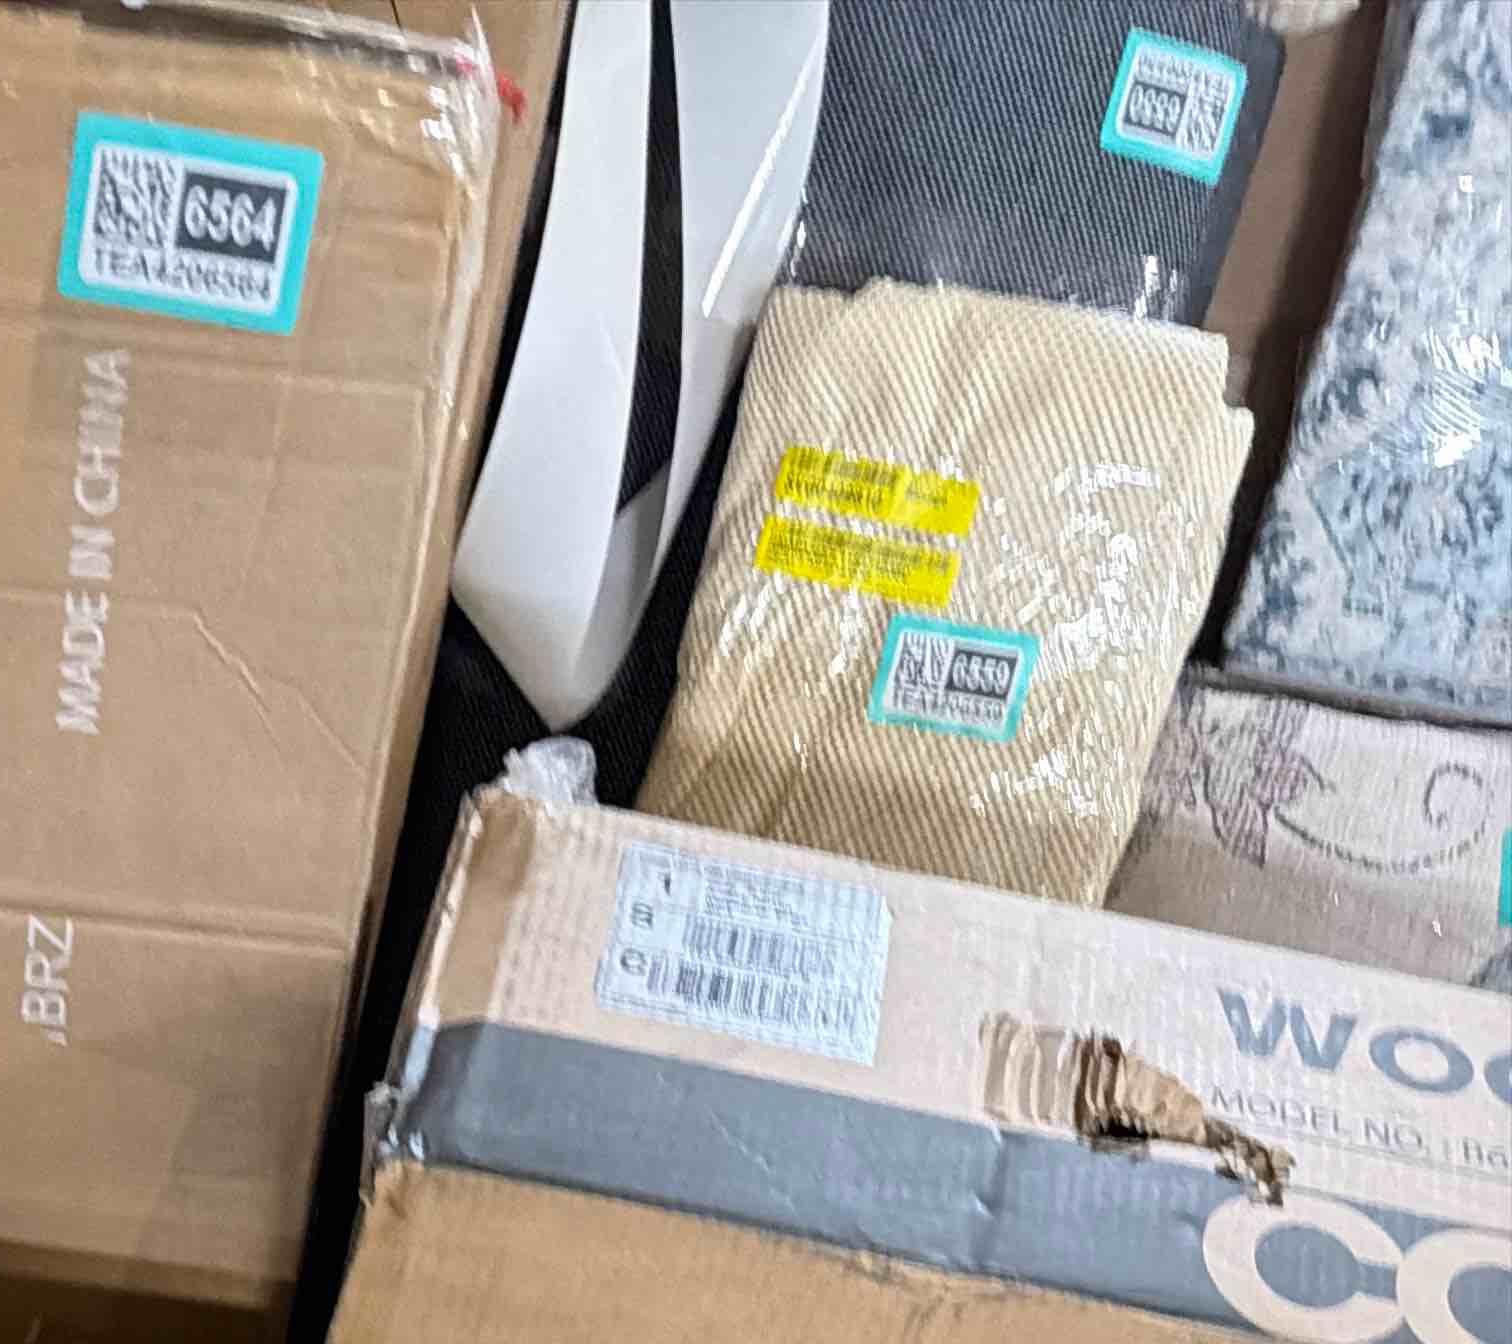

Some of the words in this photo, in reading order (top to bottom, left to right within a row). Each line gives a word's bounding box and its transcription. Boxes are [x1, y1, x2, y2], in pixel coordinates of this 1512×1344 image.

[185, 184, 278, 252] 6564
[73, 350, 131, 516] CHINA
[69, 525, 115, 580] IN
[56, 590, 111, 735] MADE
[1217, 986, 1512, 1107] WO
